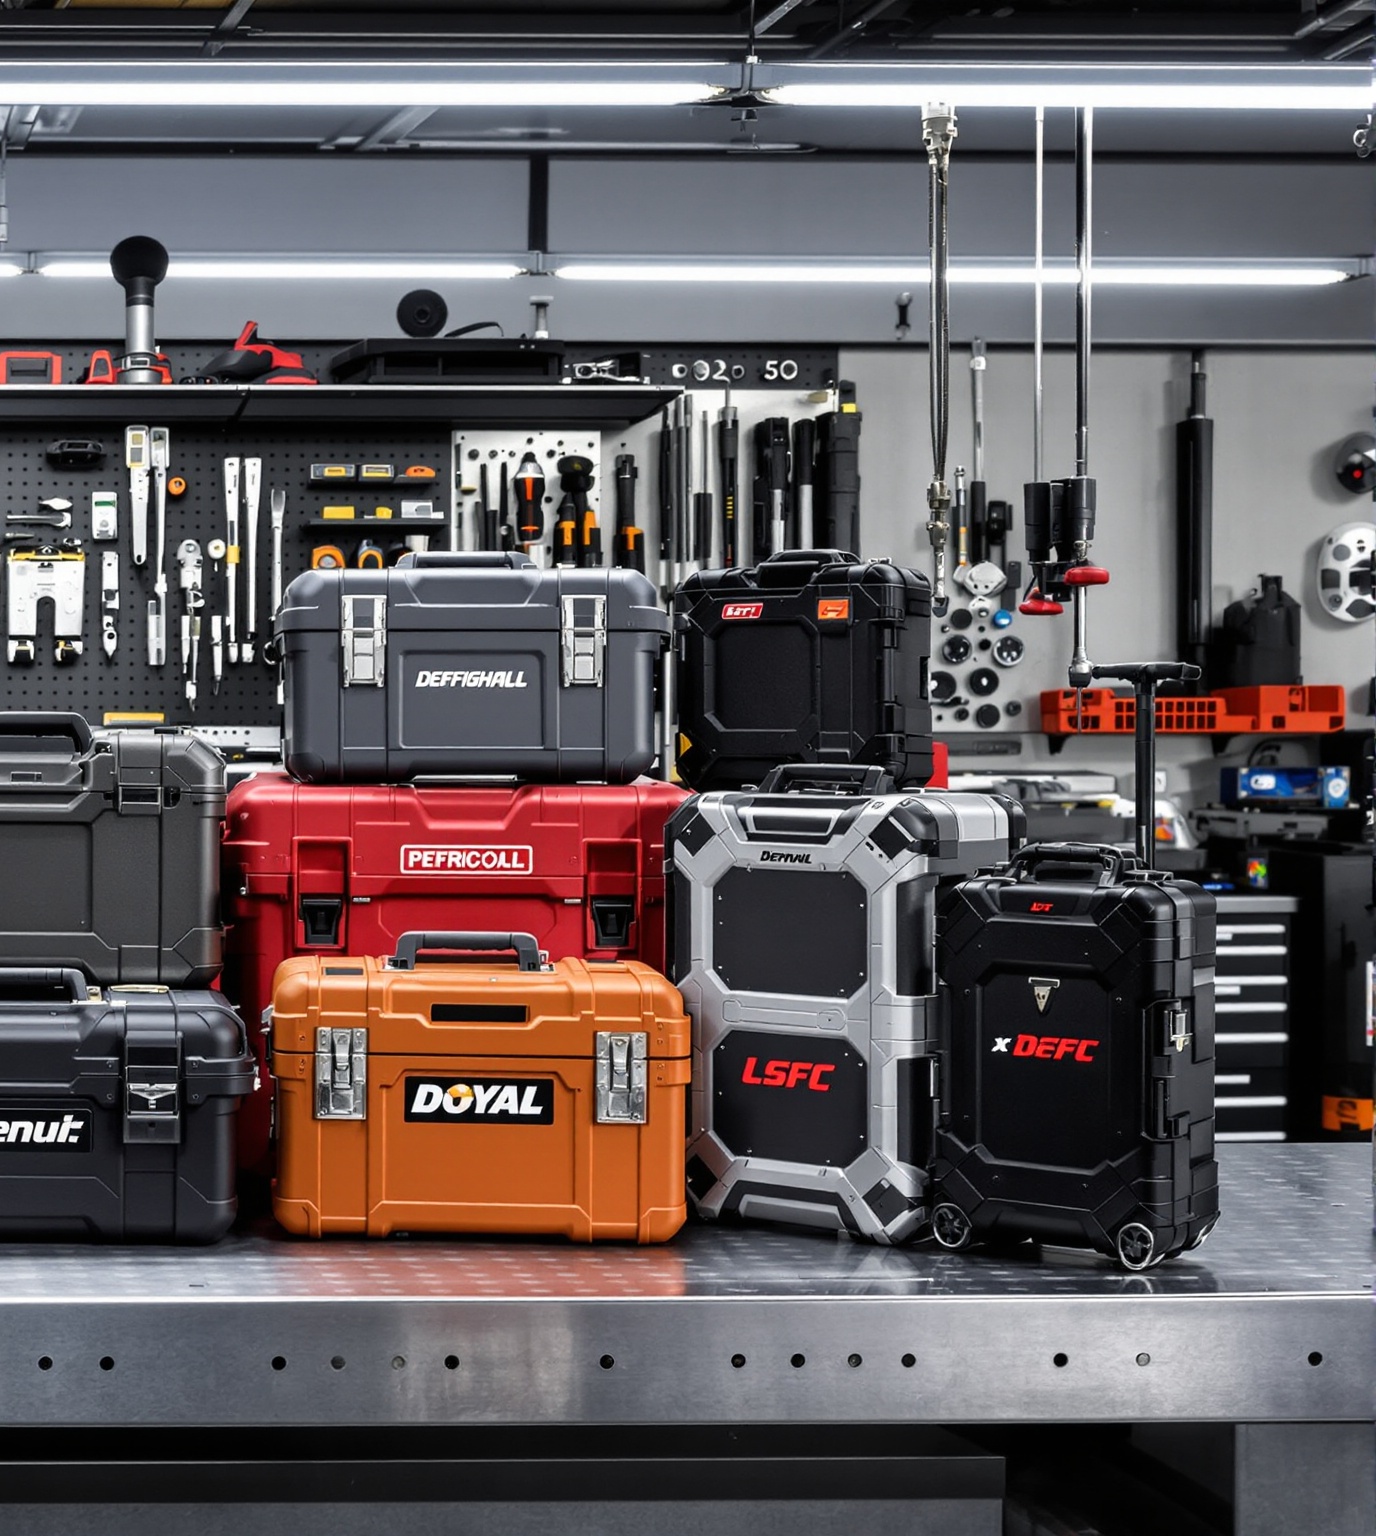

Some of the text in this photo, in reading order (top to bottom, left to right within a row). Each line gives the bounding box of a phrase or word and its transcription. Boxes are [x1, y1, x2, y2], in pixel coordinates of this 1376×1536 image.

[415, 671, 528, 688] DEFFIGHALL
[1012, 1034, 1100, 1062] DEFC
[742, 1057, 836, 1092] LSFC
[410, 1083, 543, 1115] DOYAL
